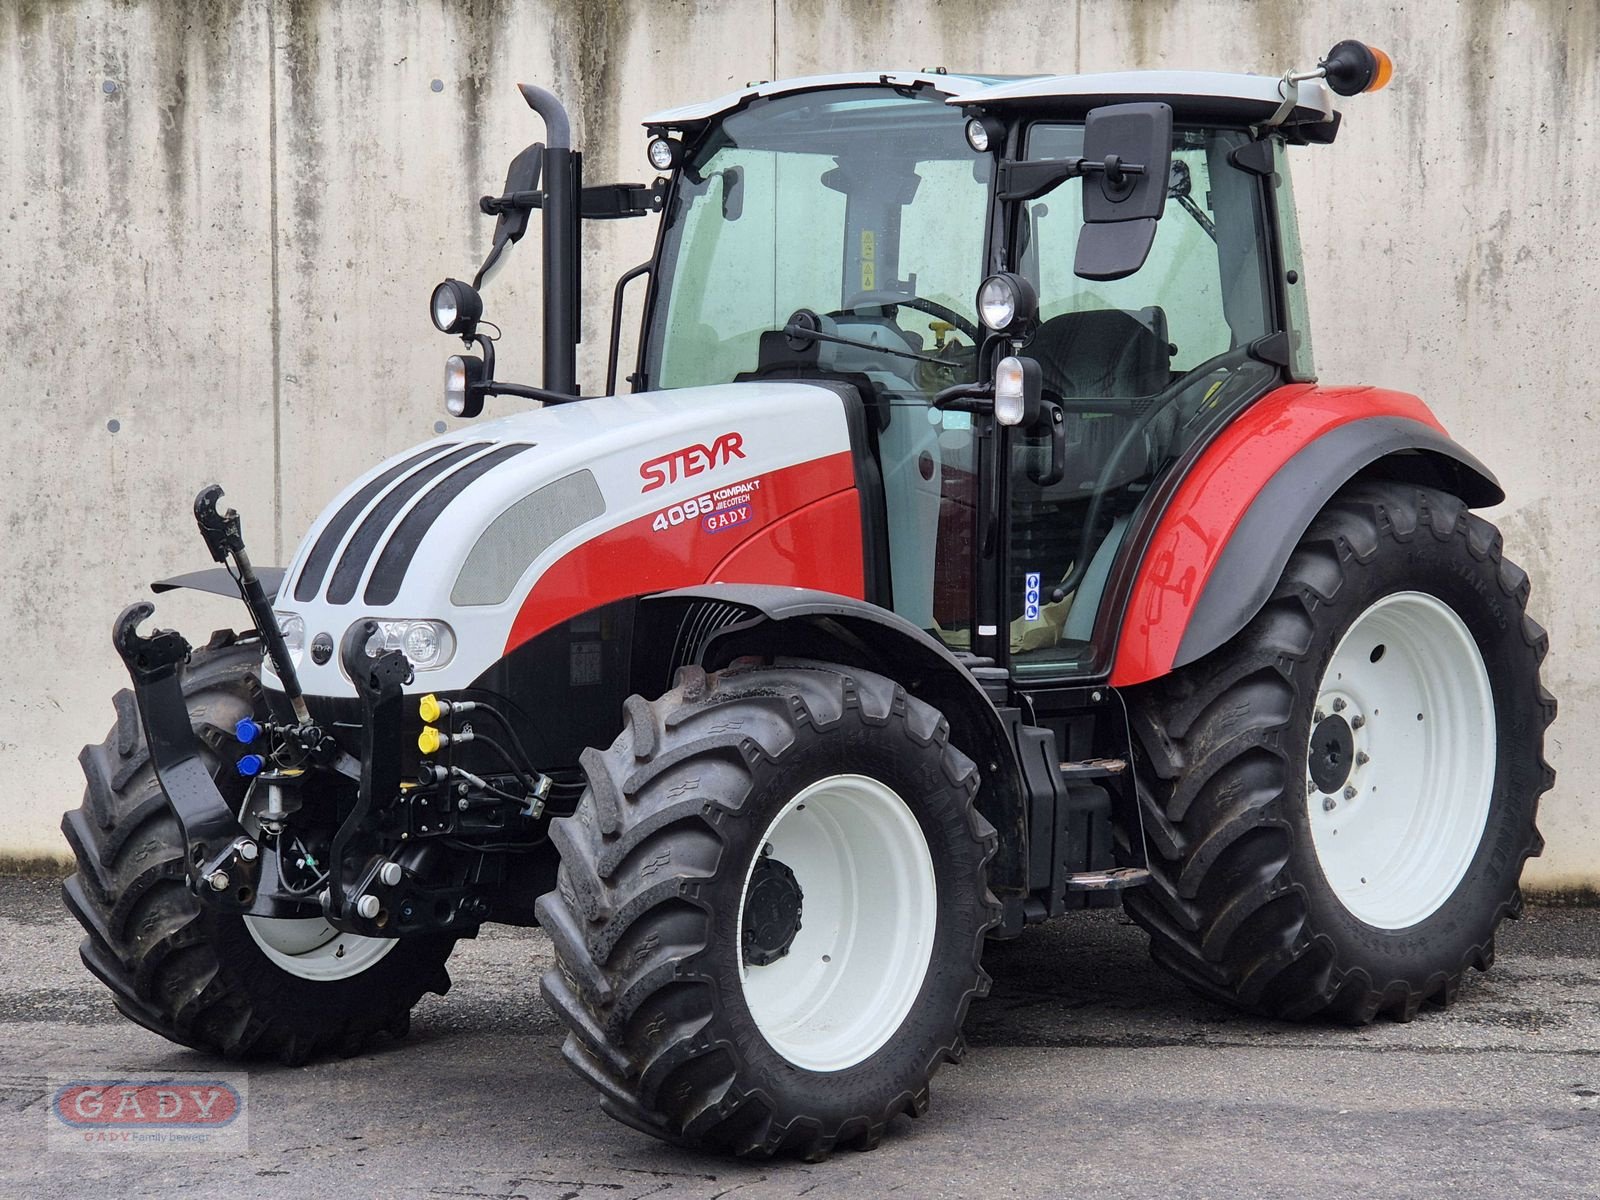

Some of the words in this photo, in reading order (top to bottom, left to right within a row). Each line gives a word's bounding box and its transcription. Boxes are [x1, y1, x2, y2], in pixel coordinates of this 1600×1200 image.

[639, 431, 747, 494] STEYR
[652, 494, 714, 532] 4095
[712, 480, 760, 501] KOMPAKT
[707, 507, 747, 530] GADY
[723, 494, 751, 510] ECOTECH
